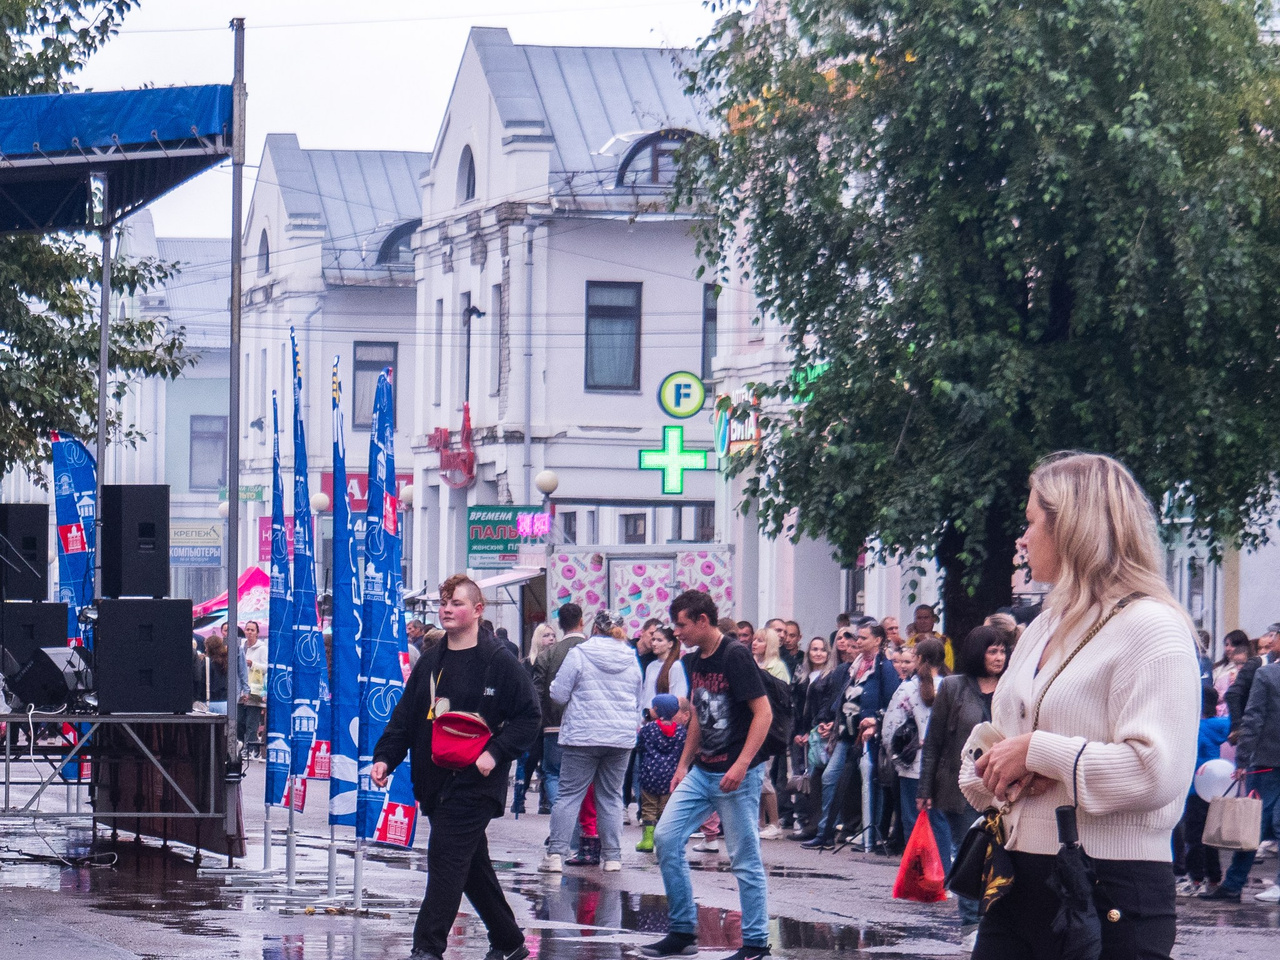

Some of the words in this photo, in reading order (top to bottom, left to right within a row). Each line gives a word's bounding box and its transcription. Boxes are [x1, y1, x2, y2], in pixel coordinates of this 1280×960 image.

[674, 384, 692, 408] F
[469, 511, 512, 521] ВРЕМЕНА
[170, 547, 220, 557] КОМПЬЮТЕРЫ
